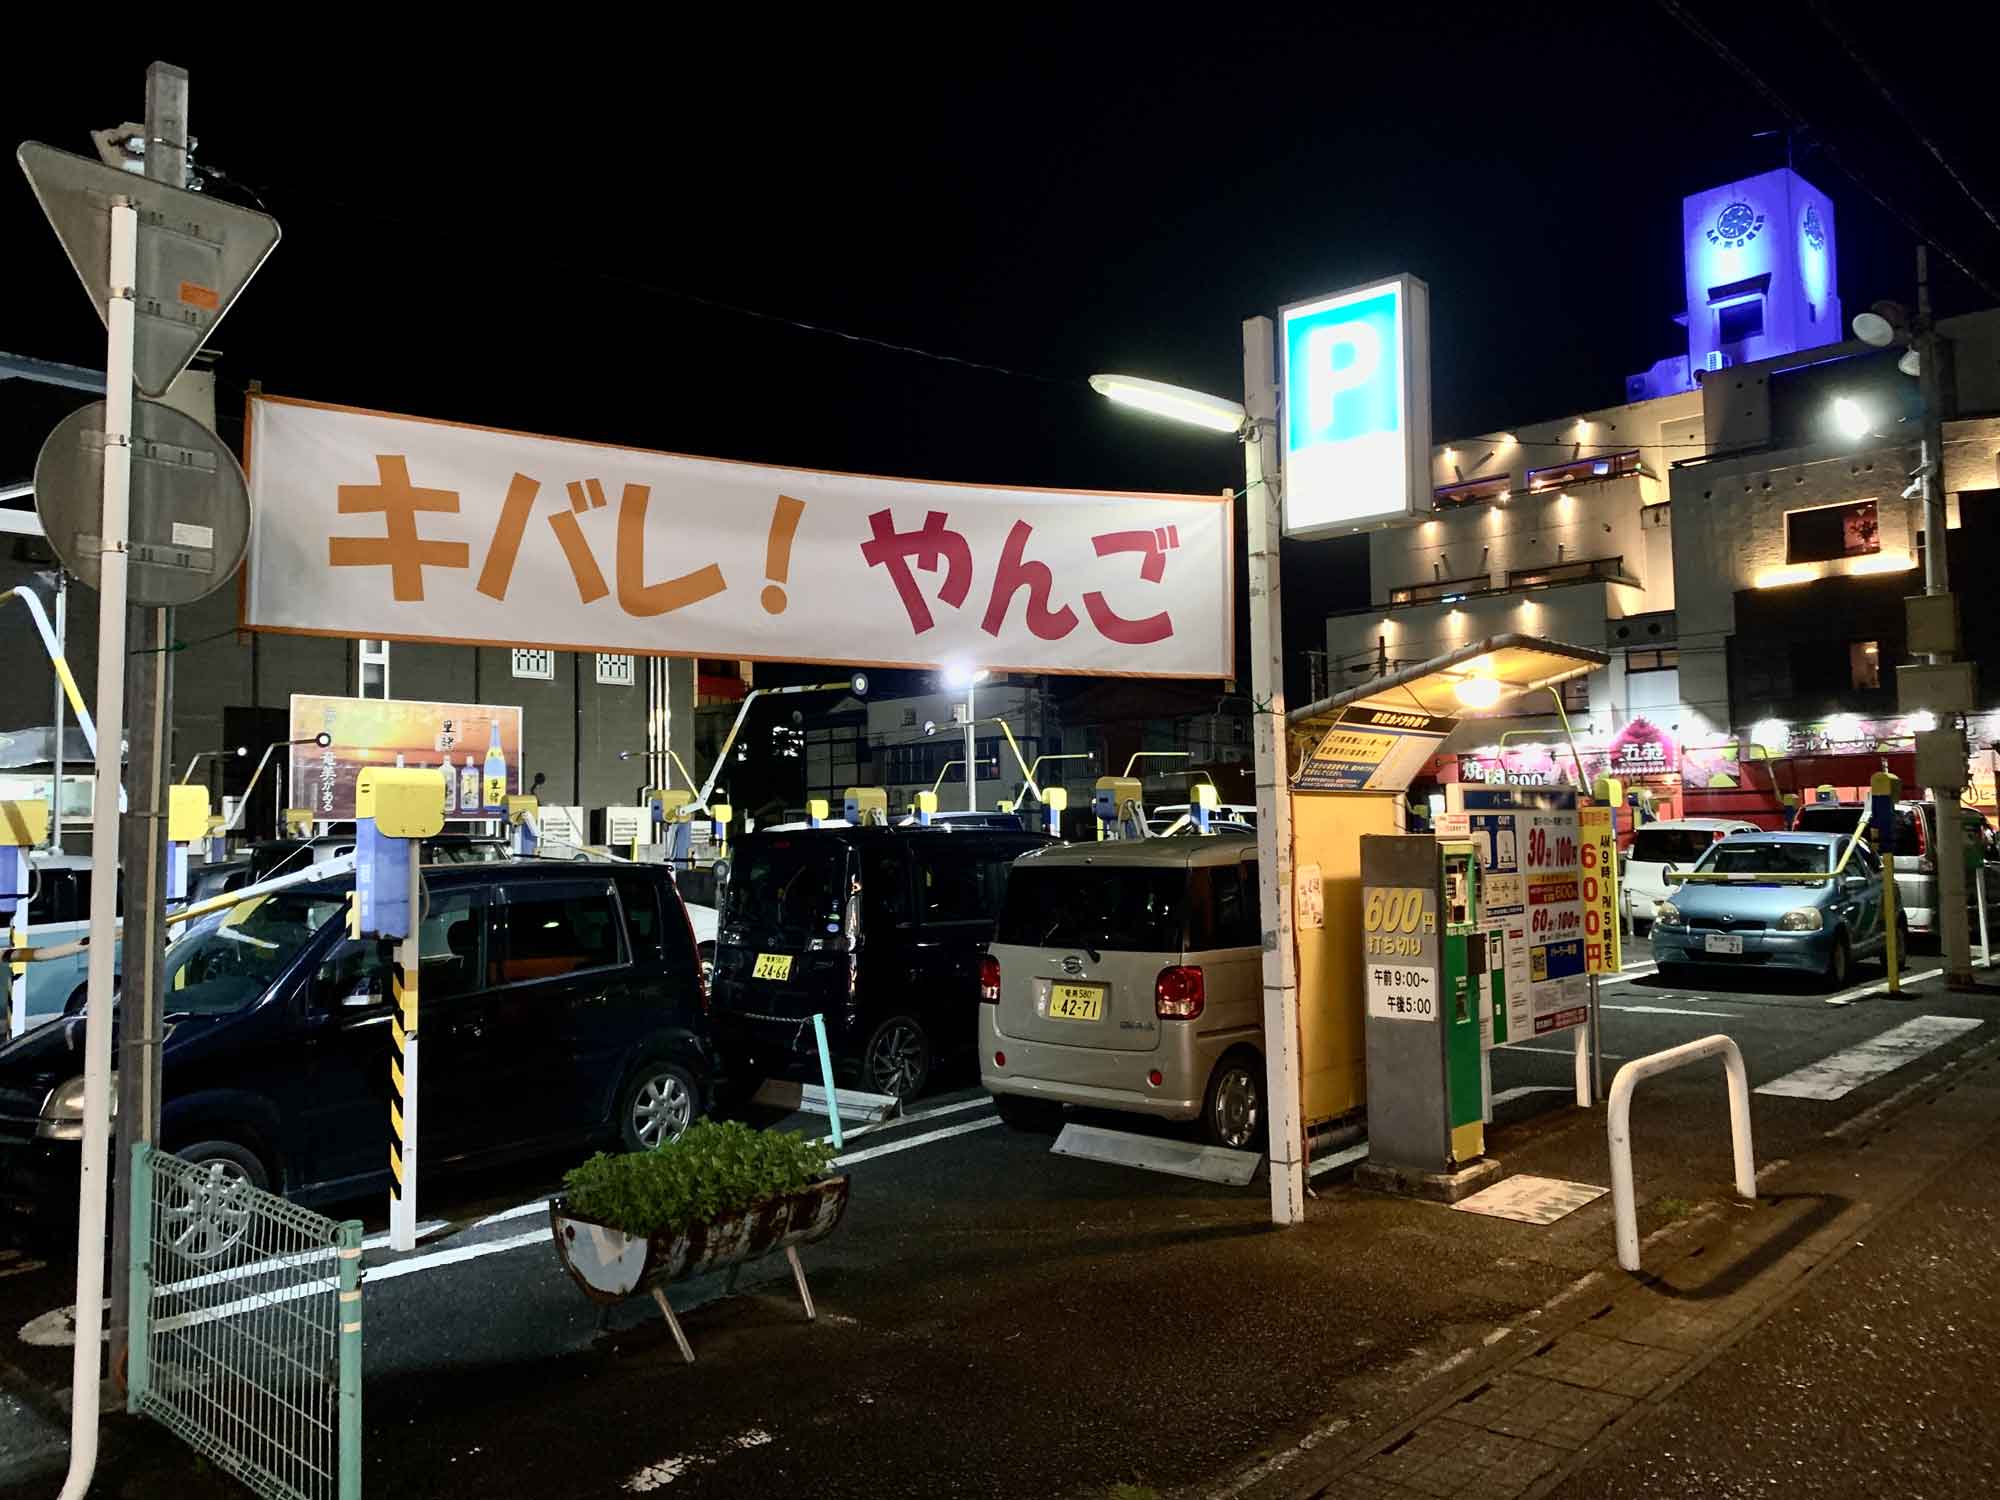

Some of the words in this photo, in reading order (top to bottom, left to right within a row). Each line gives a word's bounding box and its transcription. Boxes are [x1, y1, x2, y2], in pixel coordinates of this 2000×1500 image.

[1311, 322, 1379, 431] P
[860, 508, 1179, 645] やんご
[1368, 936, 1422, 957] 打ち切り
[1581, 843, 1602, 971] 600円
[1387, 996, 1431, 1014] 午後5:00
